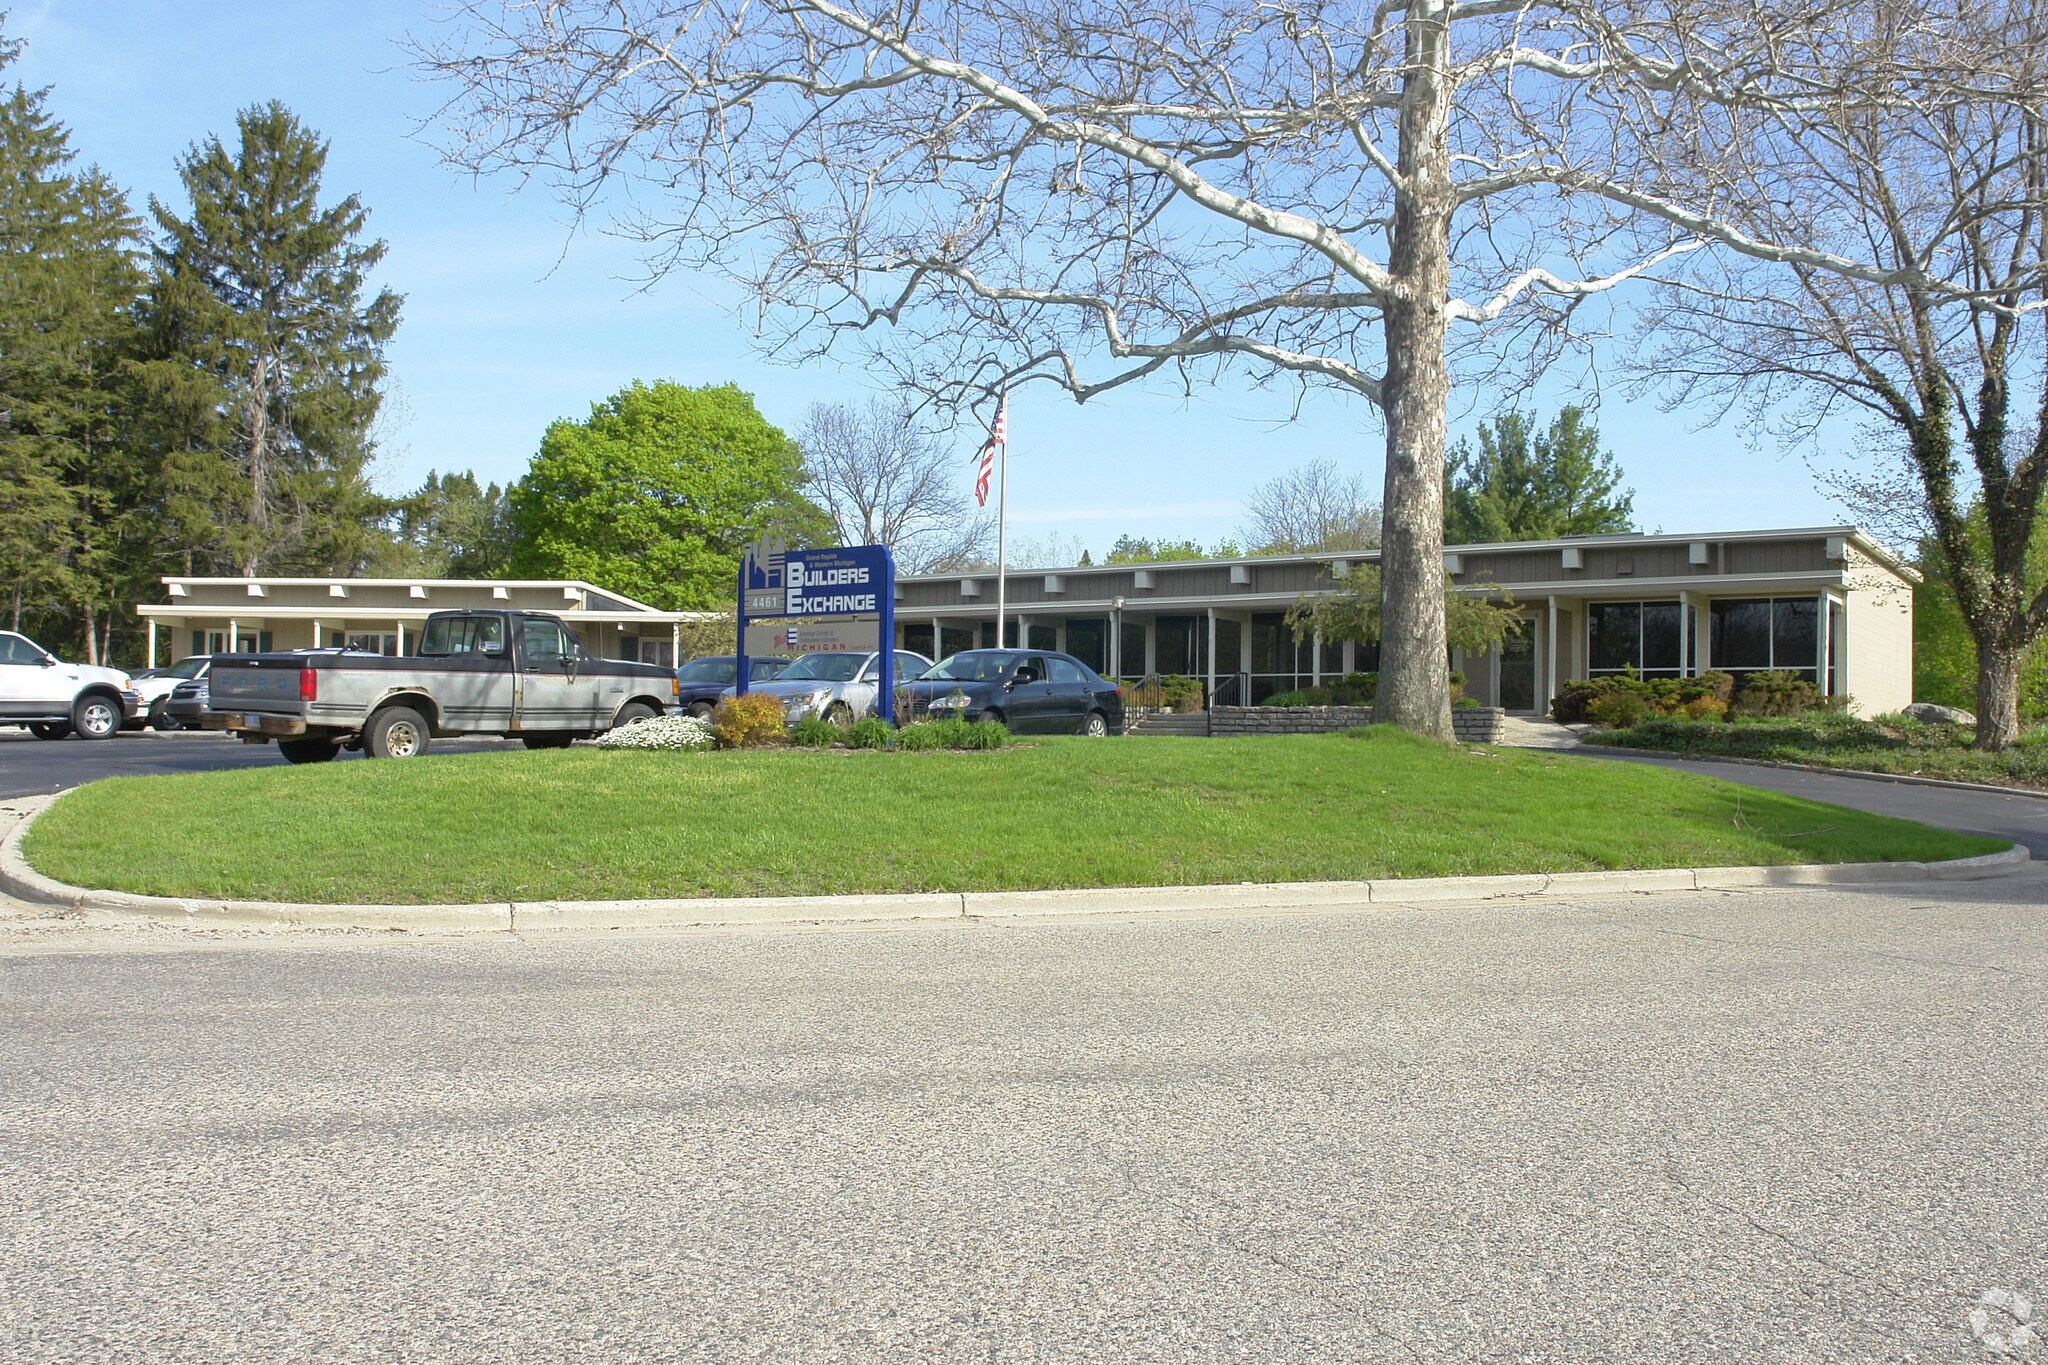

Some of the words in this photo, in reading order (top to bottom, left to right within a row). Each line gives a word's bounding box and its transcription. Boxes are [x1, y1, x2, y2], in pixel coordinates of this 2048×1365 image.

[787, 561, 869, 588] BUILDERS
[752, 596, 777, 608] 4461
[787, 588, 876, 614] EXCHANGE
[787, 642, 846, 652] MICHIGAN
[221, 675, 288, 690] FORD
